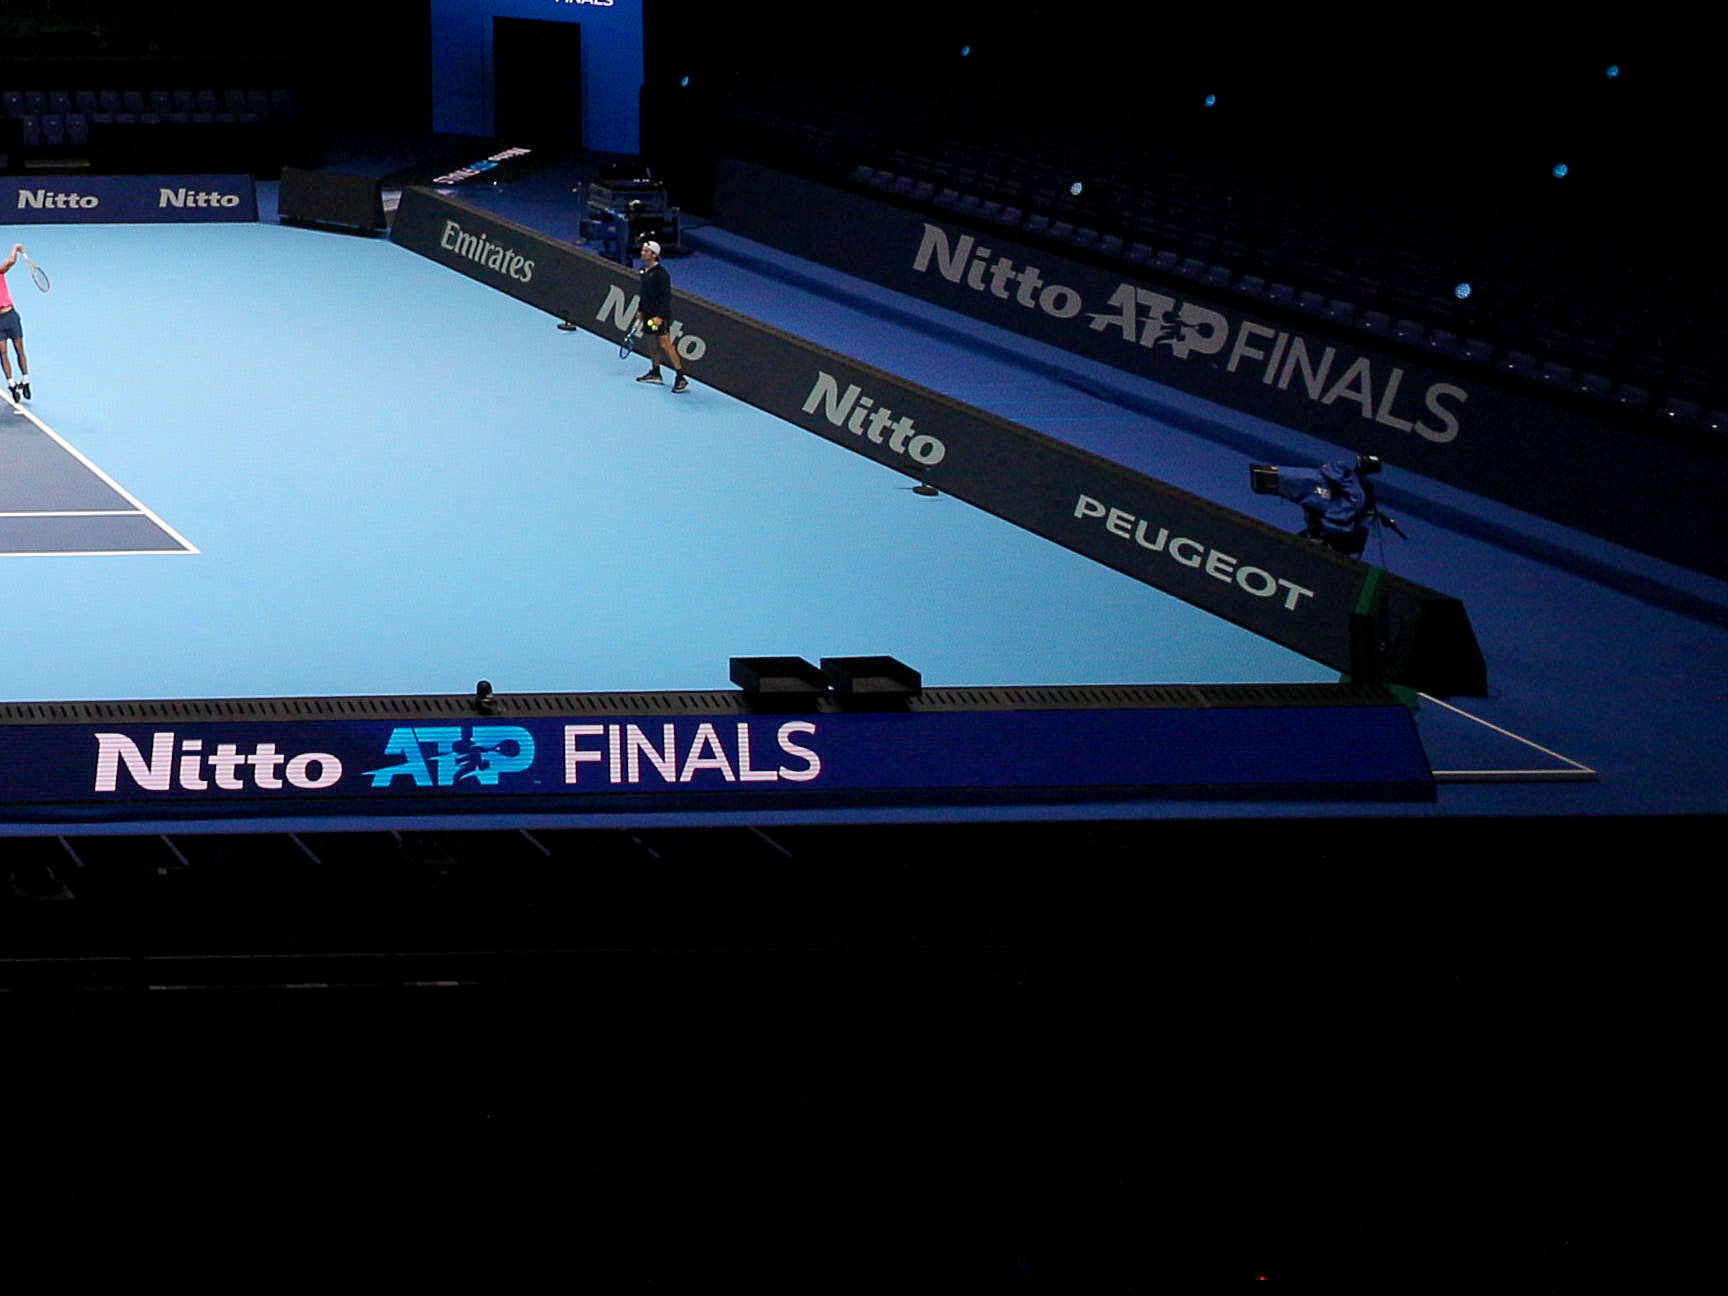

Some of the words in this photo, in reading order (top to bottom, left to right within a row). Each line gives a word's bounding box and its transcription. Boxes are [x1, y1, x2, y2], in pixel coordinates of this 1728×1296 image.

[17, 189, 99, 209] Nitto
[159, 188, 240, 208] Nitto
[440, 220, 535, 283] Emirates
[912, 222, 1083, 319] Nitto
[1087, 283, 1230, 360] ATP
[1227, 320, 1469, 444] FINALS
[801, 370, 946, 466] Nitto
[1073, 493, 1314, 612] PEUGEOT
[94, 731, 343, 792] Nitto
[361, 726, 536, 788] ATP
[564, 720, 821, 784] FINALS
